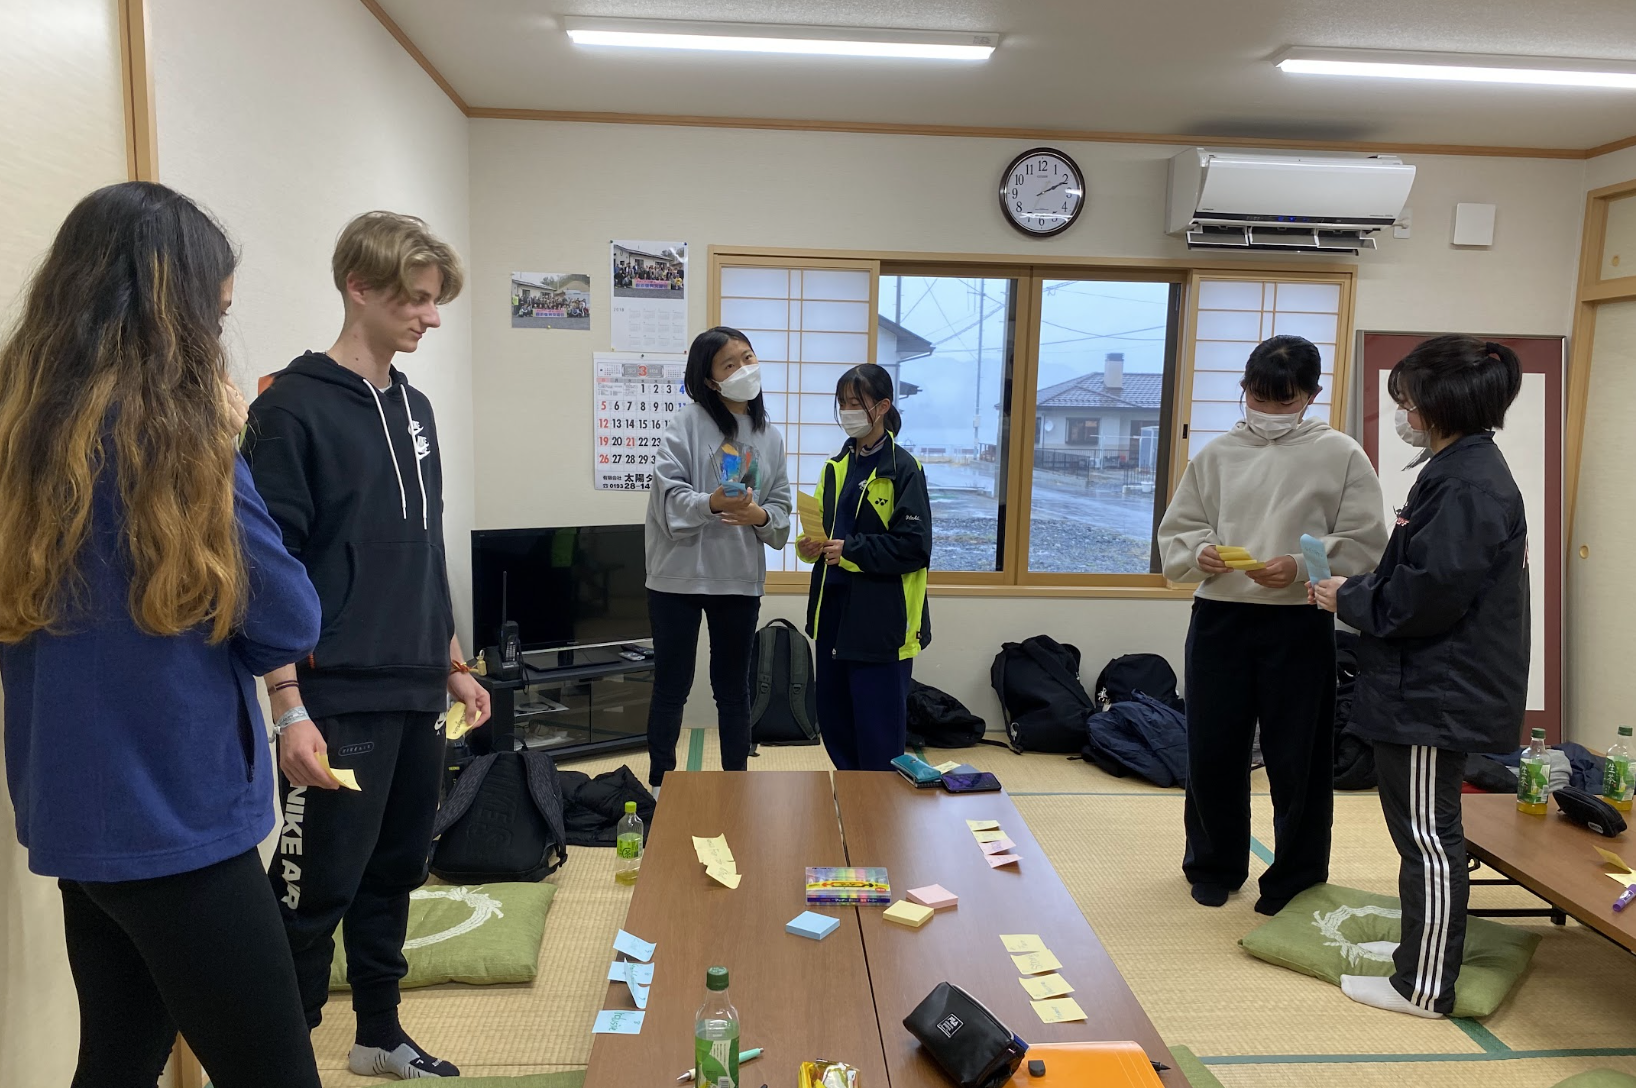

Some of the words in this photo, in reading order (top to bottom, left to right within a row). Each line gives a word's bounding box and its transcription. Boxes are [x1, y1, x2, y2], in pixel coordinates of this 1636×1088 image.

[1026, 164, 1033, 175] 11
[1038, 160, 1048, 171] 12
[1054, 164, 1057, 175] 1
[1015, 174, 1024, 185] 10
[1062, 174, 1068, 184] 2
[1012, 188, 1018, 199] 9
[1016, 201, 1022, 212] 8
[1062, 201, 1068, 212] 4
[1039, 216, 1044, 226] 6
[638, 366, 647, 376] 3
[641, 384, 644, 393] 1
[654, 385, 658, 393] 2
[666, 385, 671, 393] 3
[679, 385, 685, 394] 4
[601, 401, 606, 410] 5
[614, 401, 619, 410] 6
[627, 402, 632, 410] 7
[641, 402, 645, 411] 8
[654, 402, 658, 411] 9
[665, 402, 674, 411] 10
[599, 419, 608, 428] 12
[612, 419, 621, 428] 13
[626, 419, 634, 428] 14
[639, 420, 647, 429] 15
[652, 420, 660, 429] 16
[600, 437, 609, 446] 19
[612, 437, 622, 446] 20
[626, 438, 635, 446] 21
[638, 438, 648, 446] 22
[652, 438, 661, 447] 23
[600, 455, 609, 463] 26
[612, 455, 622, 464] 27
[626, 455, 635, 464] 28
[639, 455, 648, 464] 29
[651, 455, 655, 464] 3
[281, 783, 307, 856] NIKE
[281, 859, 301, 910] AIR
